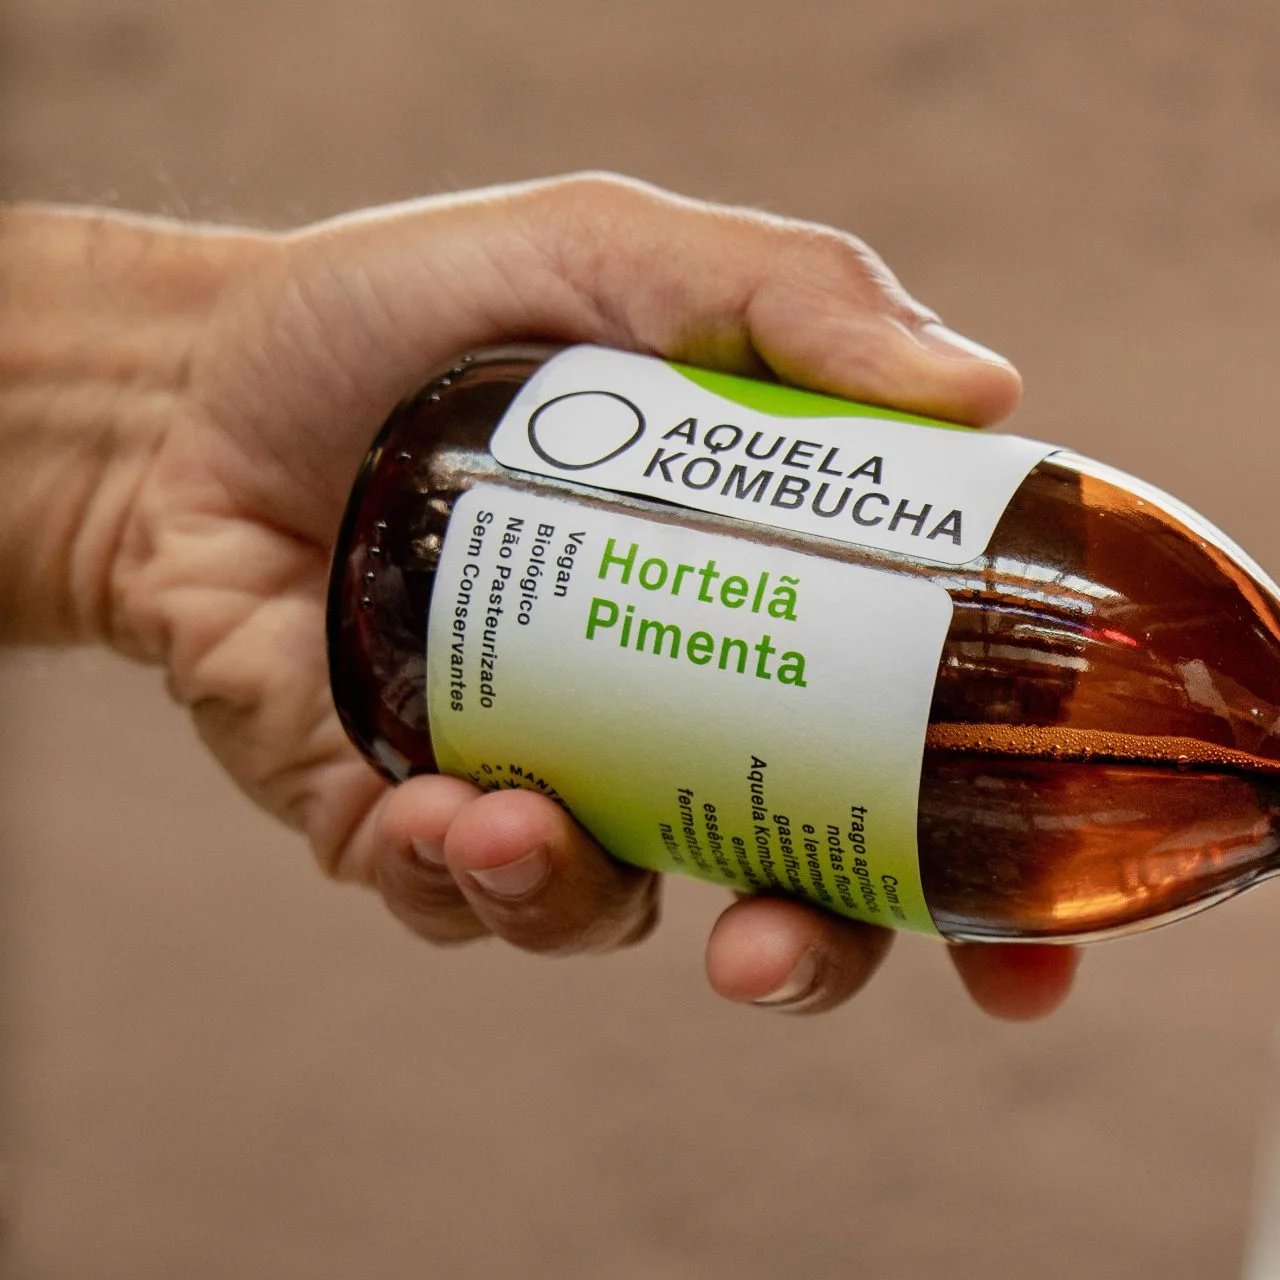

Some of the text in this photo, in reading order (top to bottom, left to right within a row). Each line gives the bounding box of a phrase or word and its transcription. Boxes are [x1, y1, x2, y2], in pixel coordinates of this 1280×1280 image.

[661, 417, 885, 485] AQUELA
[643, 447, 963, 547] KOMBUCHA
[517, 522, 555, 626] Biológico
[554, 530, 587, 598] Vegan
[597, 537, 801, 622] Hortelã
[450, 510, 493, 712] Sem Conservantes
[480, 516, 525, 709] Não Pasteurizado
[585, 597, 808, 688] Pimenta
[747, 755, 784, 889] Aquela Kombuc
[802, 823, 816, 835] e
[827, 824, 845, 872] notas
[848, 806, 868, 855] trago
[882, 874, 901, 908] Com
